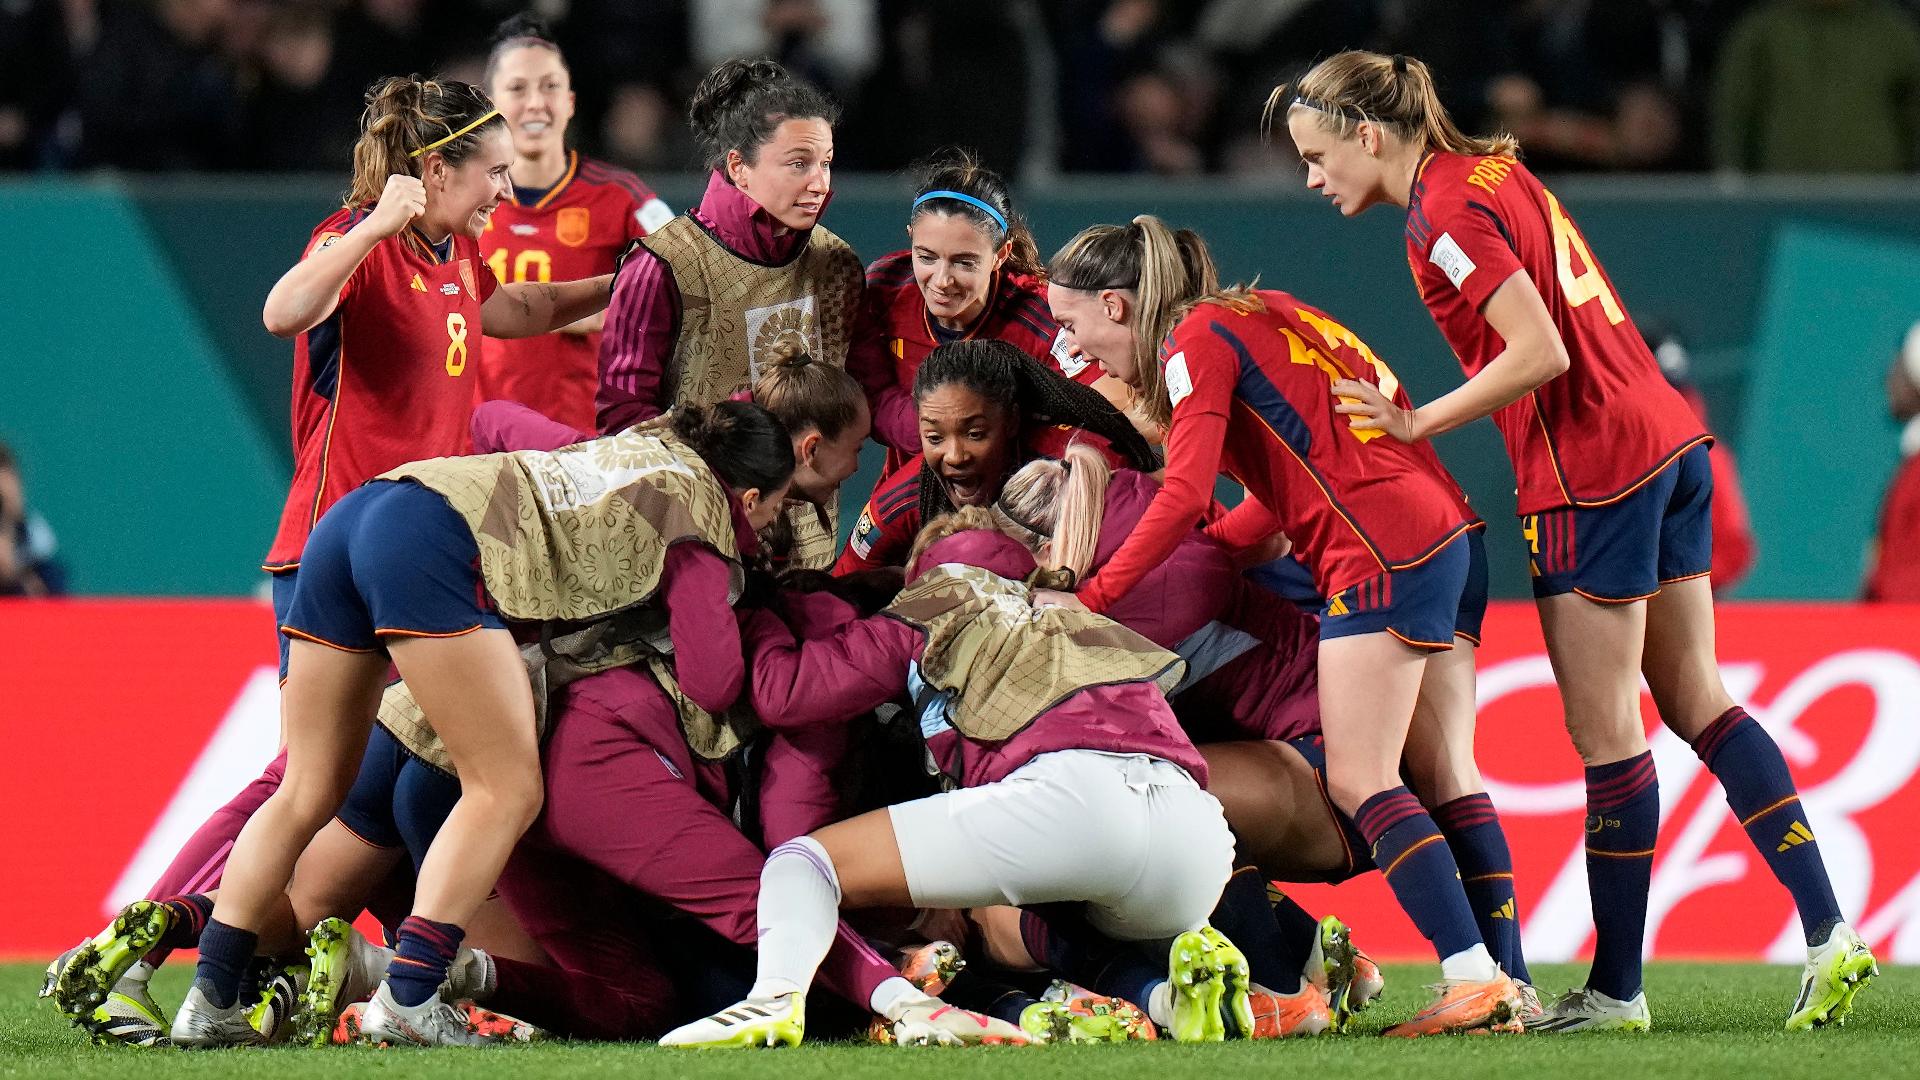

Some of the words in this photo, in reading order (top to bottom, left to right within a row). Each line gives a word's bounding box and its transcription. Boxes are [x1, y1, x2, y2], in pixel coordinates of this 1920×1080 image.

[487, 247, 552, 283] 10
[1542, 188, 1626, 326] 4
[445, 312, 467, 377] 8
[1522, 514, 1540, 554] 4
